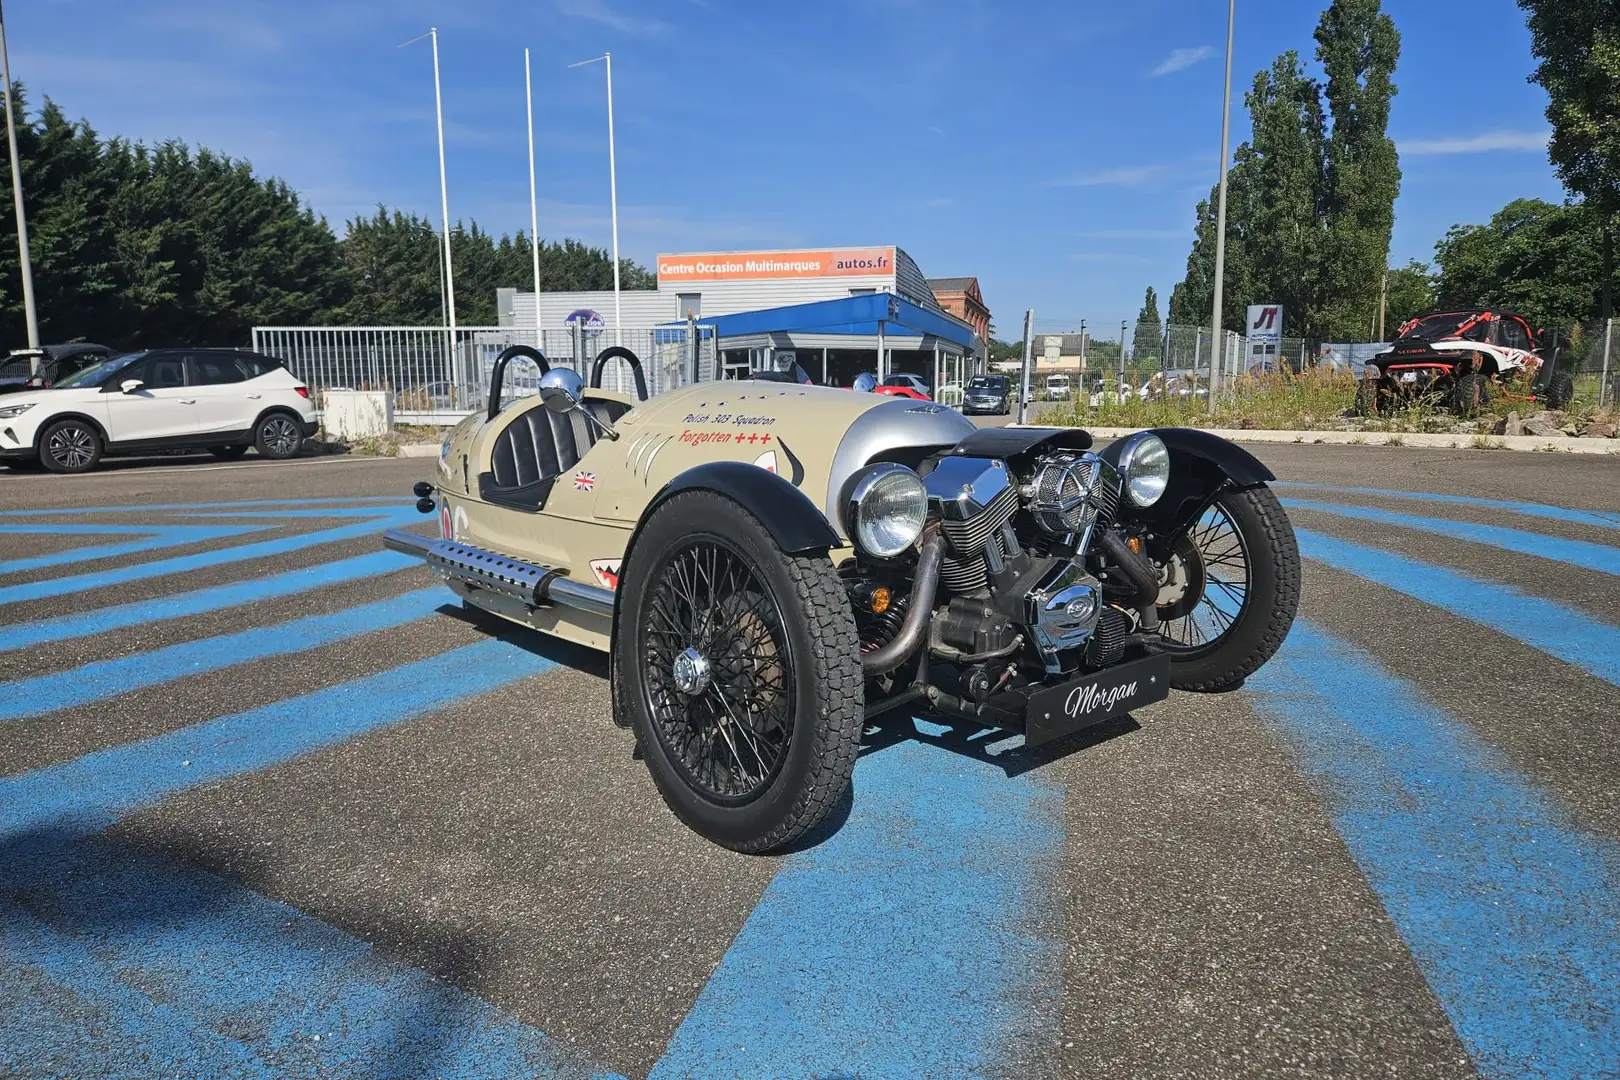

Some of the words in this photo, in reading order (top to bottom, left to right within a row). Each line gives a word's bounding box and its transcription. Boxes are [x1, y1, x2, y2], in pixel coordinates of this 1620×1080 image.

[660, 263, 695, 275] Centre
[696, 261, 743, 274] Occasion
[745, 259, 821, 273] Multimarques
[837, 256, 888, 270] autos.fr
[682, 413, 710, 423] Polish
[711, 414, 732, 424] 303
[732, 415, 776, 427] Squadron
[678, 429, 732, 446] Forgotten
[1064, 681, 1138, 718] Morgan
